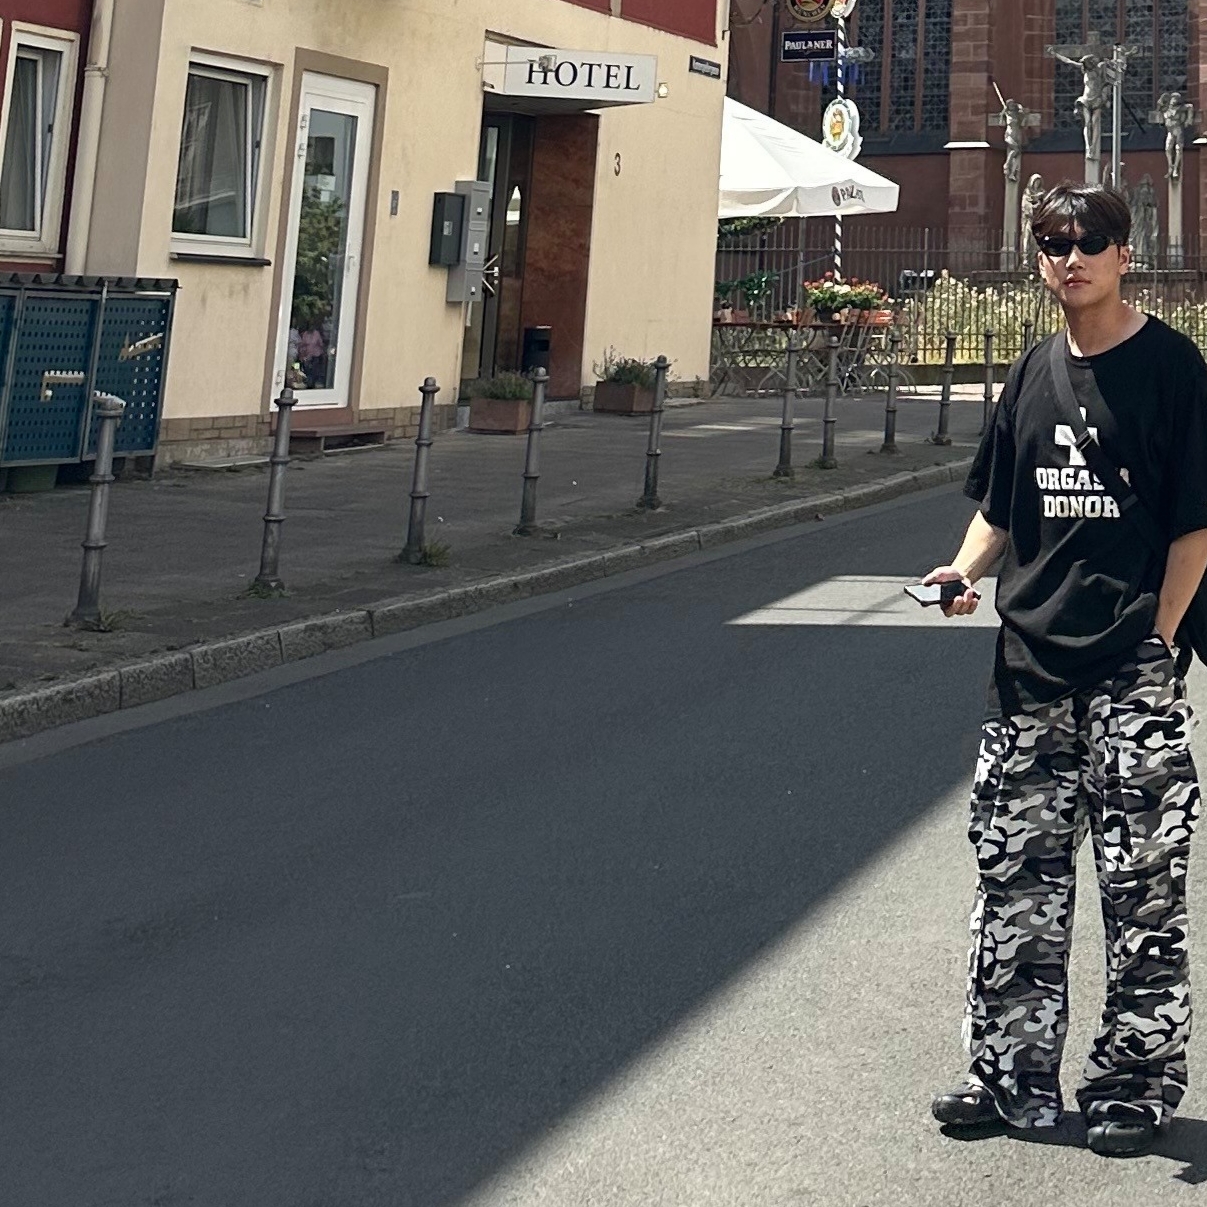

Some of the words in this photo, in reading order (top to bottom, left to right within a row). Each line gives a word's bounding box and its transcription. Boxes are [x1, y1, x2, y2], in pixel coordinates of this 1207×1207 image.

[784, 39, 834, 51] PAULANER
[525, 58, 641, 91] HOTEL
[613, 152, 622, 177] 3
[1042, 495, 1121, 518] DONOR
